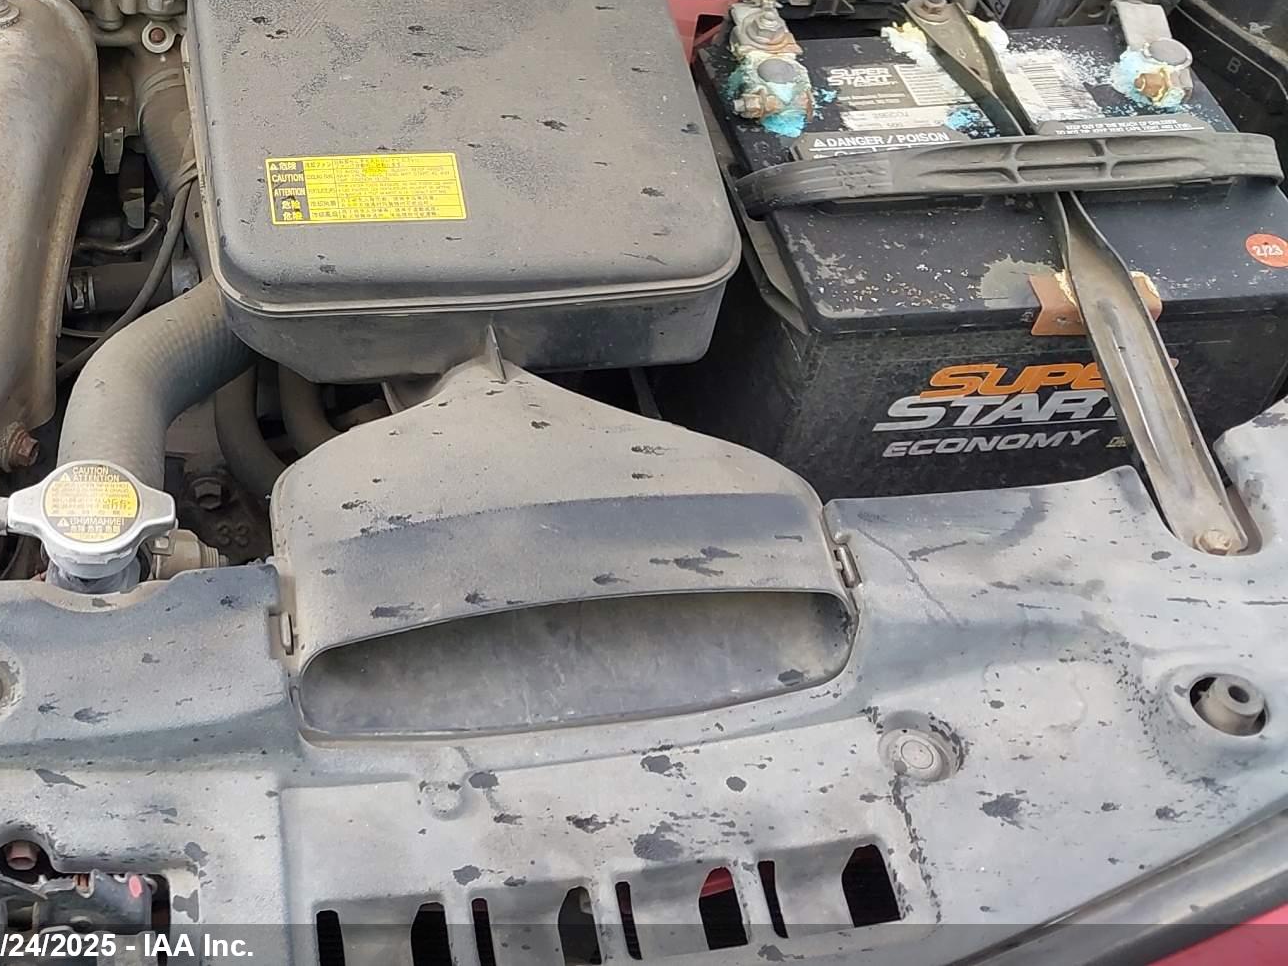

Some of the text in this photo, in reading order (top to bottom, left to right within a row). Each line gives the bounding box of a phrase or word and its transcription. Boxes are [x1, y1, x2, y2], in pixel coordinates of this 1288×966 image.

[829, 68, 889, 77] SUPER
[827, 76, 894, 86] START
[826, 136, 884, 147] DANGER
[898, 132, 950, 143] POISON
[272, 174, 304, 182] CAUTION
[274, 187, 306, 197] ATTENTION
[919, 362, 1106, 399] SUPE
[882, 429, 1100, 458] ECONOMY
[72, 466, 109, 474] CAUTION
